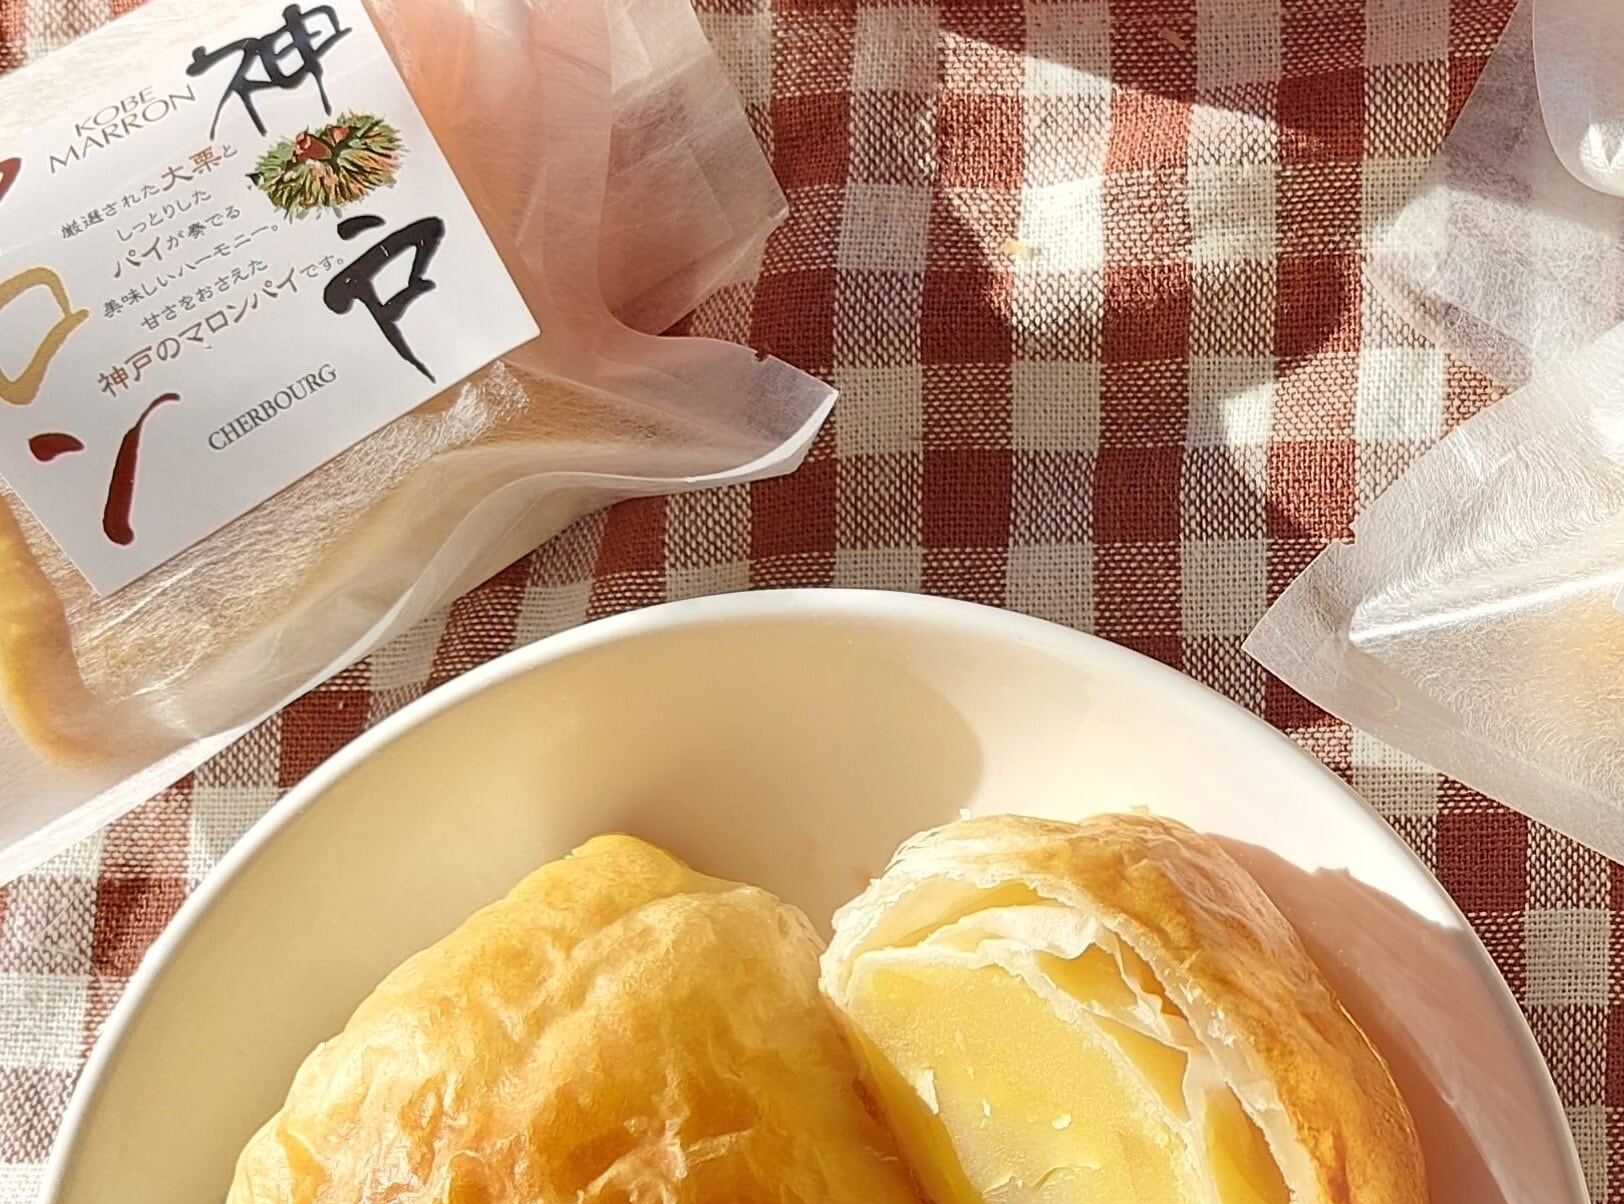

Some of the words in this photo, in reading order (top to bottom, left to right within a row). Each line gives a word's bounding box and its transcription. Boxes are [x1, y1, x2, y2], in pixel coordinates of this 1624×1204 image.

[49, 84, 196, 174] MARRON
[75, 86, 154, 138] KOBE
[60, 144, 238, 239] 厳選された大栗と
[116, 189, 212, 242] しっとりした
[113, 205, 241, 279] パイが奏でる
[97, 253, 344, 398] 神戸のマロンパイです。
[140, 258, 269, 331] 甘さをおさえた
[207, 362, 338, 451] CHERBOURG
